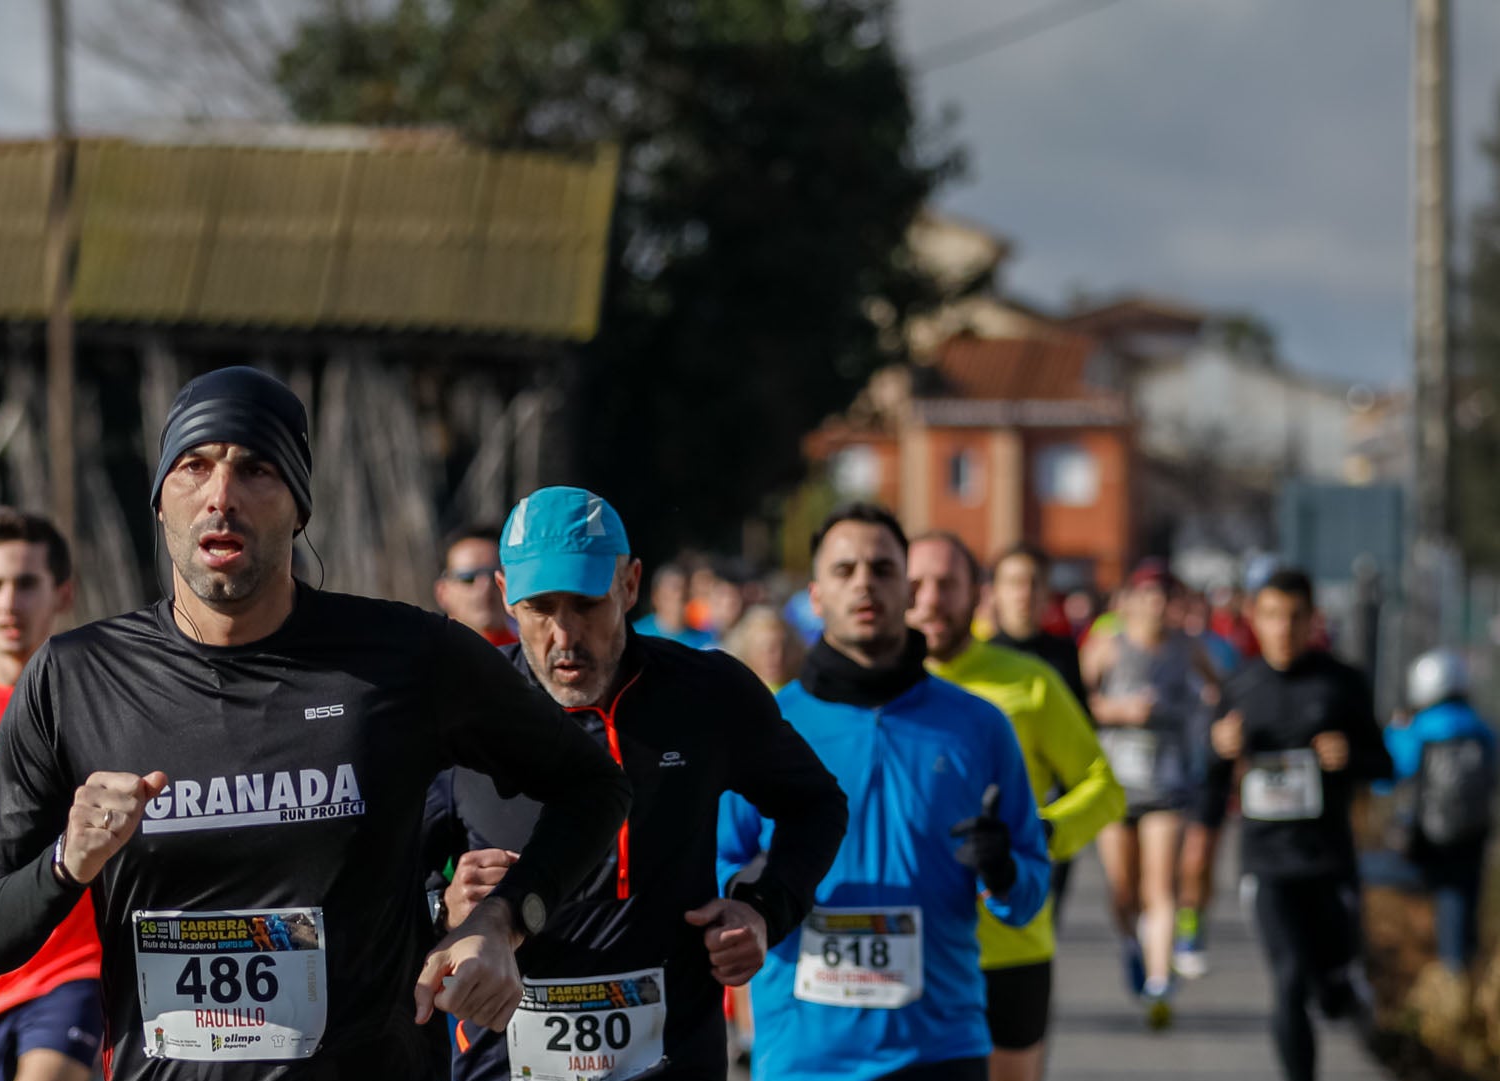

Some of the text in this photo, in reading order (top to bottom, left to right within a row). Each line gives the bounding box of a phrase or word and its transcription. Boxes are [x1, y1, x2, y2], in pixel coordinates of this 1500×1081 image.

[144, 763, 361, 819] GRANADA
[280, 801, 365, 822] RUN PROJECT
[140, 921, 157, 933] 26
[180, 919, 248, 931] CARRERA
[181, 930, 248, 940] POPULAR
[142, 940, 216, 950] Ruta de los Secaderos
[823, 935, 889, 968] 618
[176, 955, 279, 1004] 486
[548, 984, 605, 995] CARRERA
[195, 1007, 266, 1028] RAULILLO
[225, 1033, 262, 1044] olimpo
[544, 1011, 631, 1052] 280
